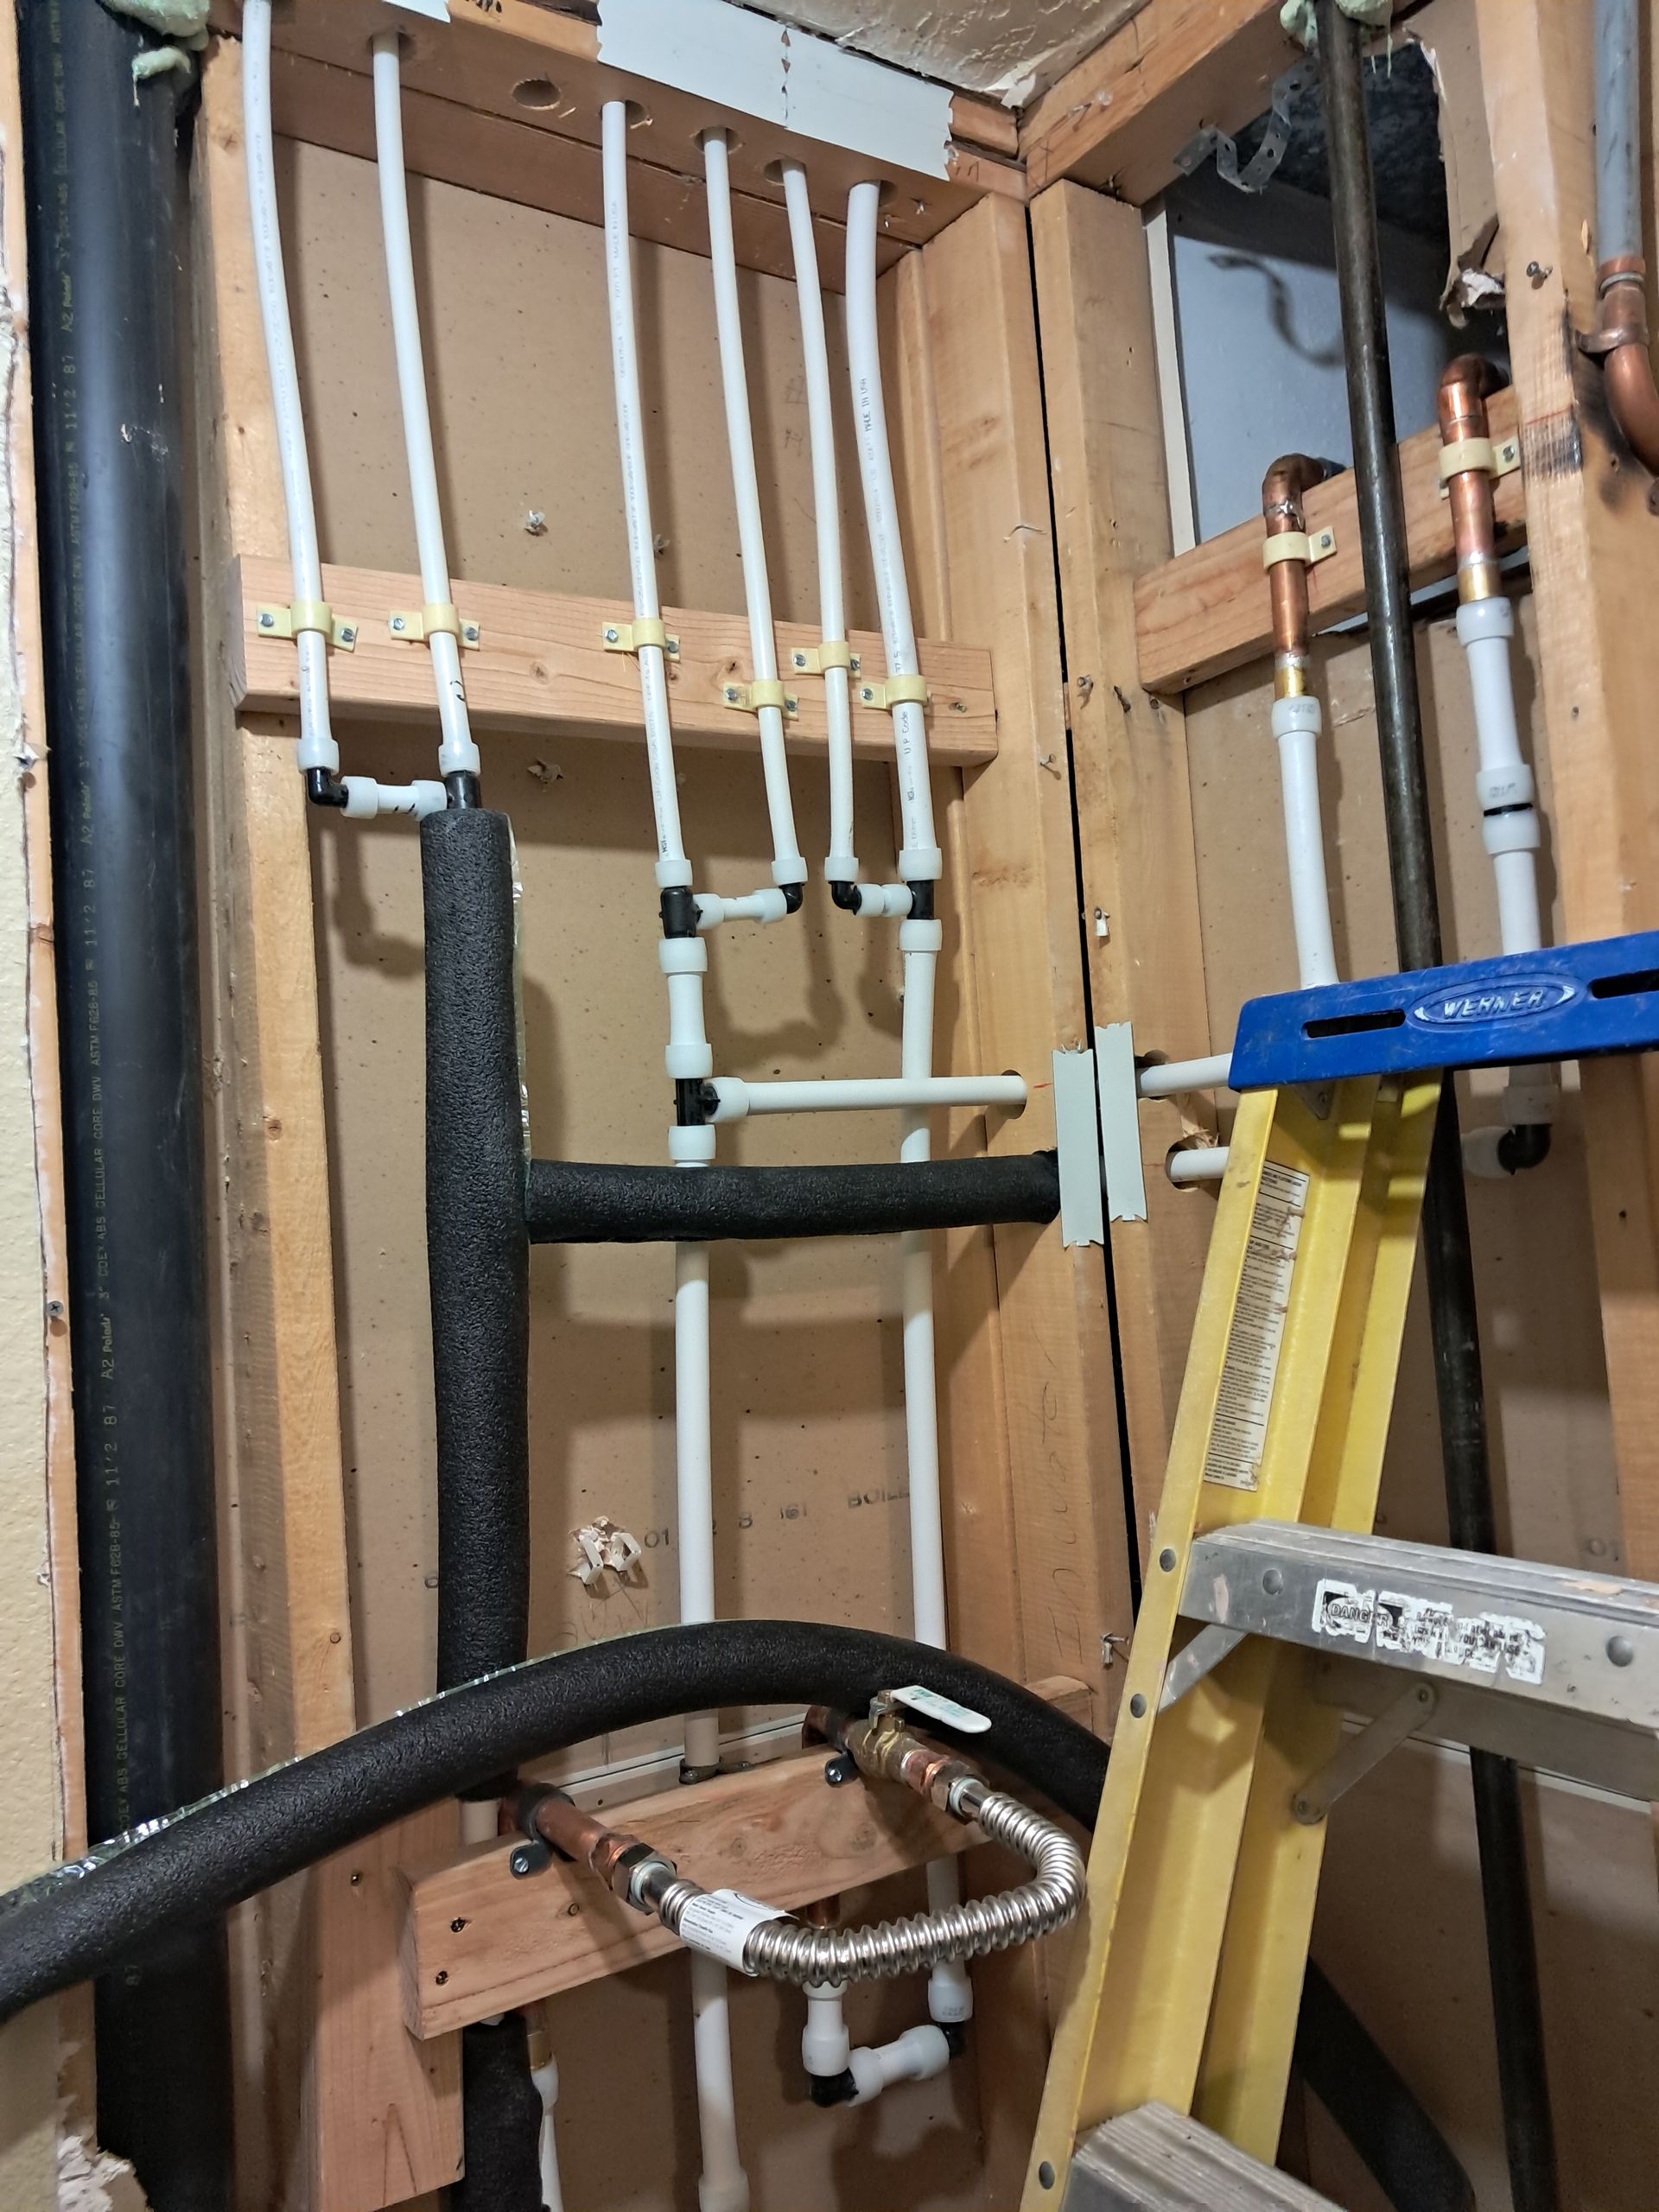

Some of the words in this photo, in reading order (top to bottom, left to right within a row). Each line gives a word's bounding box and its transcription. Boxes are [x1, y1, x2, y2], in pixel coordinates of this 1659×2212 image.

[81, 824, 94, 846] A2
[1442, 988, 1545, 1020] WERNER
[90, 1035, 101, 1068] ASTM
[92, 1076, 103, 1102] DWV
[92, 1108, 105, 1140] CORE
[94, 1147, 107, 1209] CELLULAR
[96, 1216, 108, 1241] ABS
[101, 1358, 115, 1381] A2
[103, 1403, 118, 1426] 87
[111, 1580, 123, 1611] ASTM
[112, 1620, 124, 1648] DWV
[113, 1655, 126, 1688] CORE
